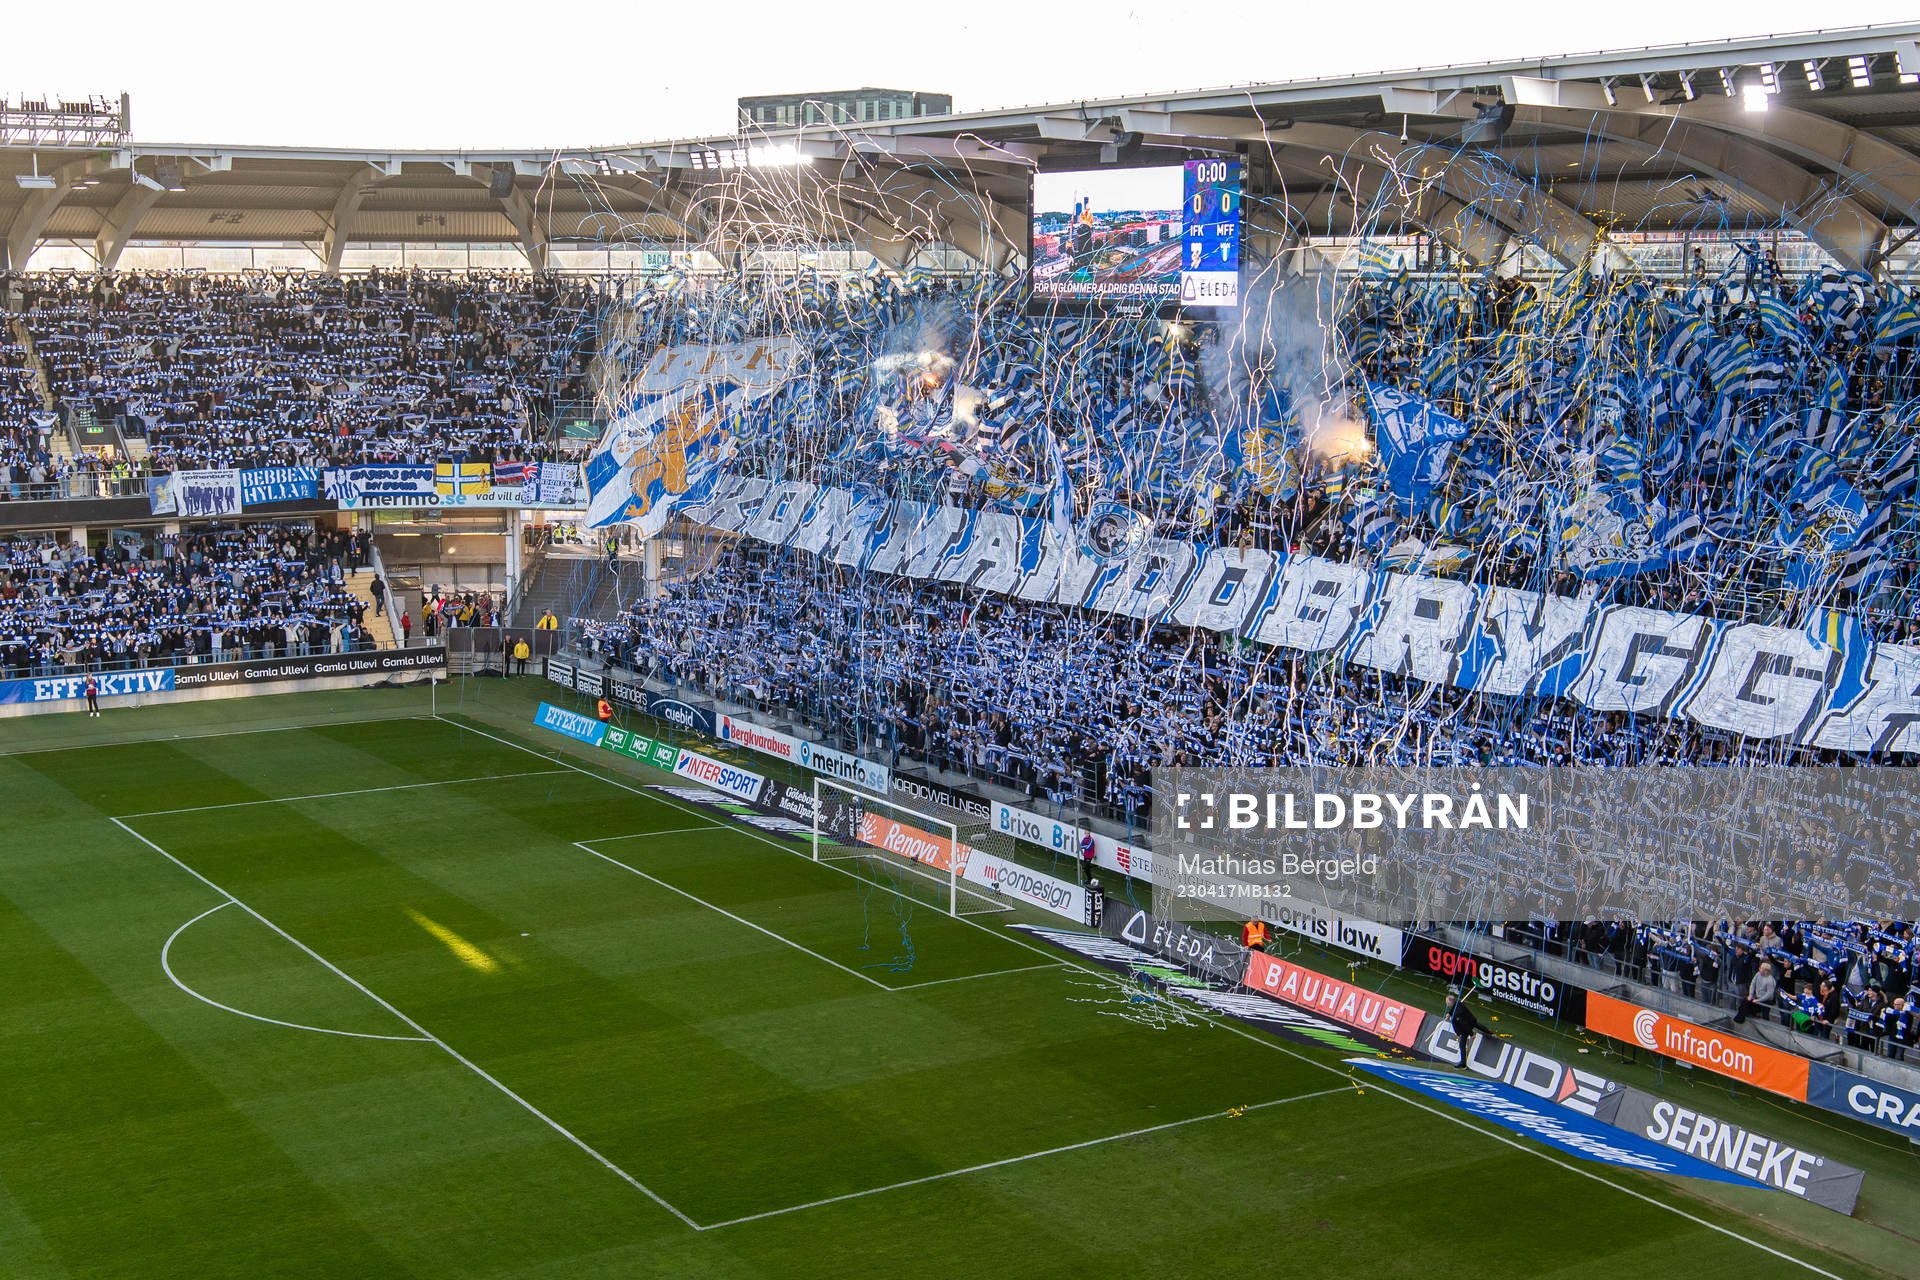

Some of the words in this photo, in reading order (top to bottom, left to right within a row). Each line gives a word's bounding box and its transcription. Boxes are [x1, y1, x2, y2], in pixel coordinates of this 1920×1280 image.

[1197, 162, 1227, 183] 0:00
[1193, 194, 1202, 214] 0
[1221, 192, 1231, 213] 0
[1189, 224, 1204, 237] IFK
[1216, 223, 1235, 237] MFF
[1033, 280, 1049, 293] FÖR
[1059, 280, 1097, 294] GLÖMMER
[1098, 282, 1128, 294] ALDRIG
[1128, 283, 1158, 294] DENNA
[1159, 283, 1181, 294] STAD
[1200, 281, 1237, 297] ELEDA
[242, 466, 318, 487] BEBBENS
[476, 491, 495, 501] vad
[497, 491, 512, 501] vill
[174, 673, 207, 685] Gamla
[209, 670, 239, 682] Ullevi
[244, 666, 278, 679] Gamla
[280, 664, 309, 677] Ullevi
[314, 661, 348, 673] Gamla
[349, 658, 377, 670] Ullevi
[382, 655, 415, 668] Gamla
[416, 653, 443, 665] Ullevi
[34, 671, 165, 701] EFFKTIV
[611, 679, 648, 706] Helanders
[544, 706, 597, 737] EFFEKTIV
[664, 704, 694, 727] cuebid
[608, 730, 624, 744] MCR
[632, 739, 648, 753] MCR
[656, 747, 673, 762] MCR
[730, 725, 791, 757] Bergkvarabuss
[687, 756, 758, 795] INTERSPORT
[813, 751, 885, 790] merinfo.se
[778, 797, 828, 823] Metallparier
[883, 823, 940, 864] Renova
[1260, 899, 1328, 937] morris
[1153, 925, 1214, 965] ELEDA
[1265, 962, 1402, 1032] BAUHAUS
[1492, 987, 1555, 1017] Storköksutrustning
[1665, 1024, 1754, 1075] InfraCom
